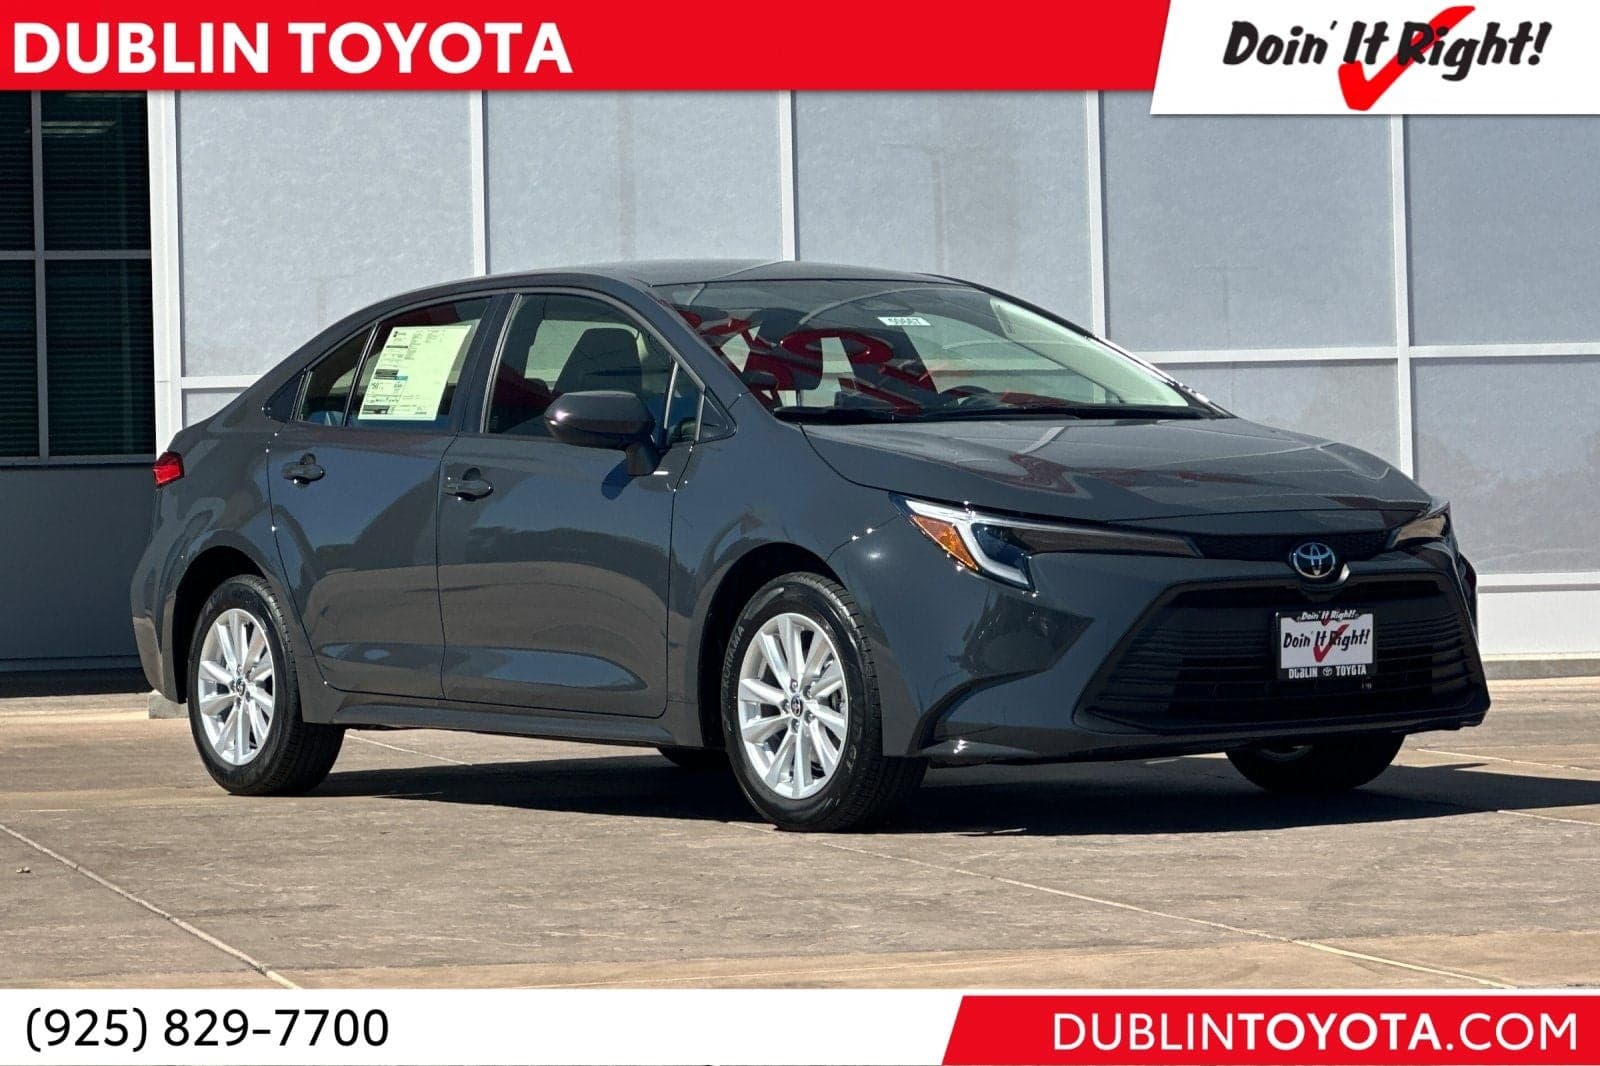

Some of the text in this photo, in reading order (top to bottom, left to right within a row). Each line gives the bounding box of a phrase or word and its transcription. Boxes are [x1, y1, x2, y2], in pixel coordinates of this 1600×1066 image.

[1283, 628, 1371, 651] Doin' It Right!
[1288, 664, 1367, 679] DUBLIN TOYOTA
